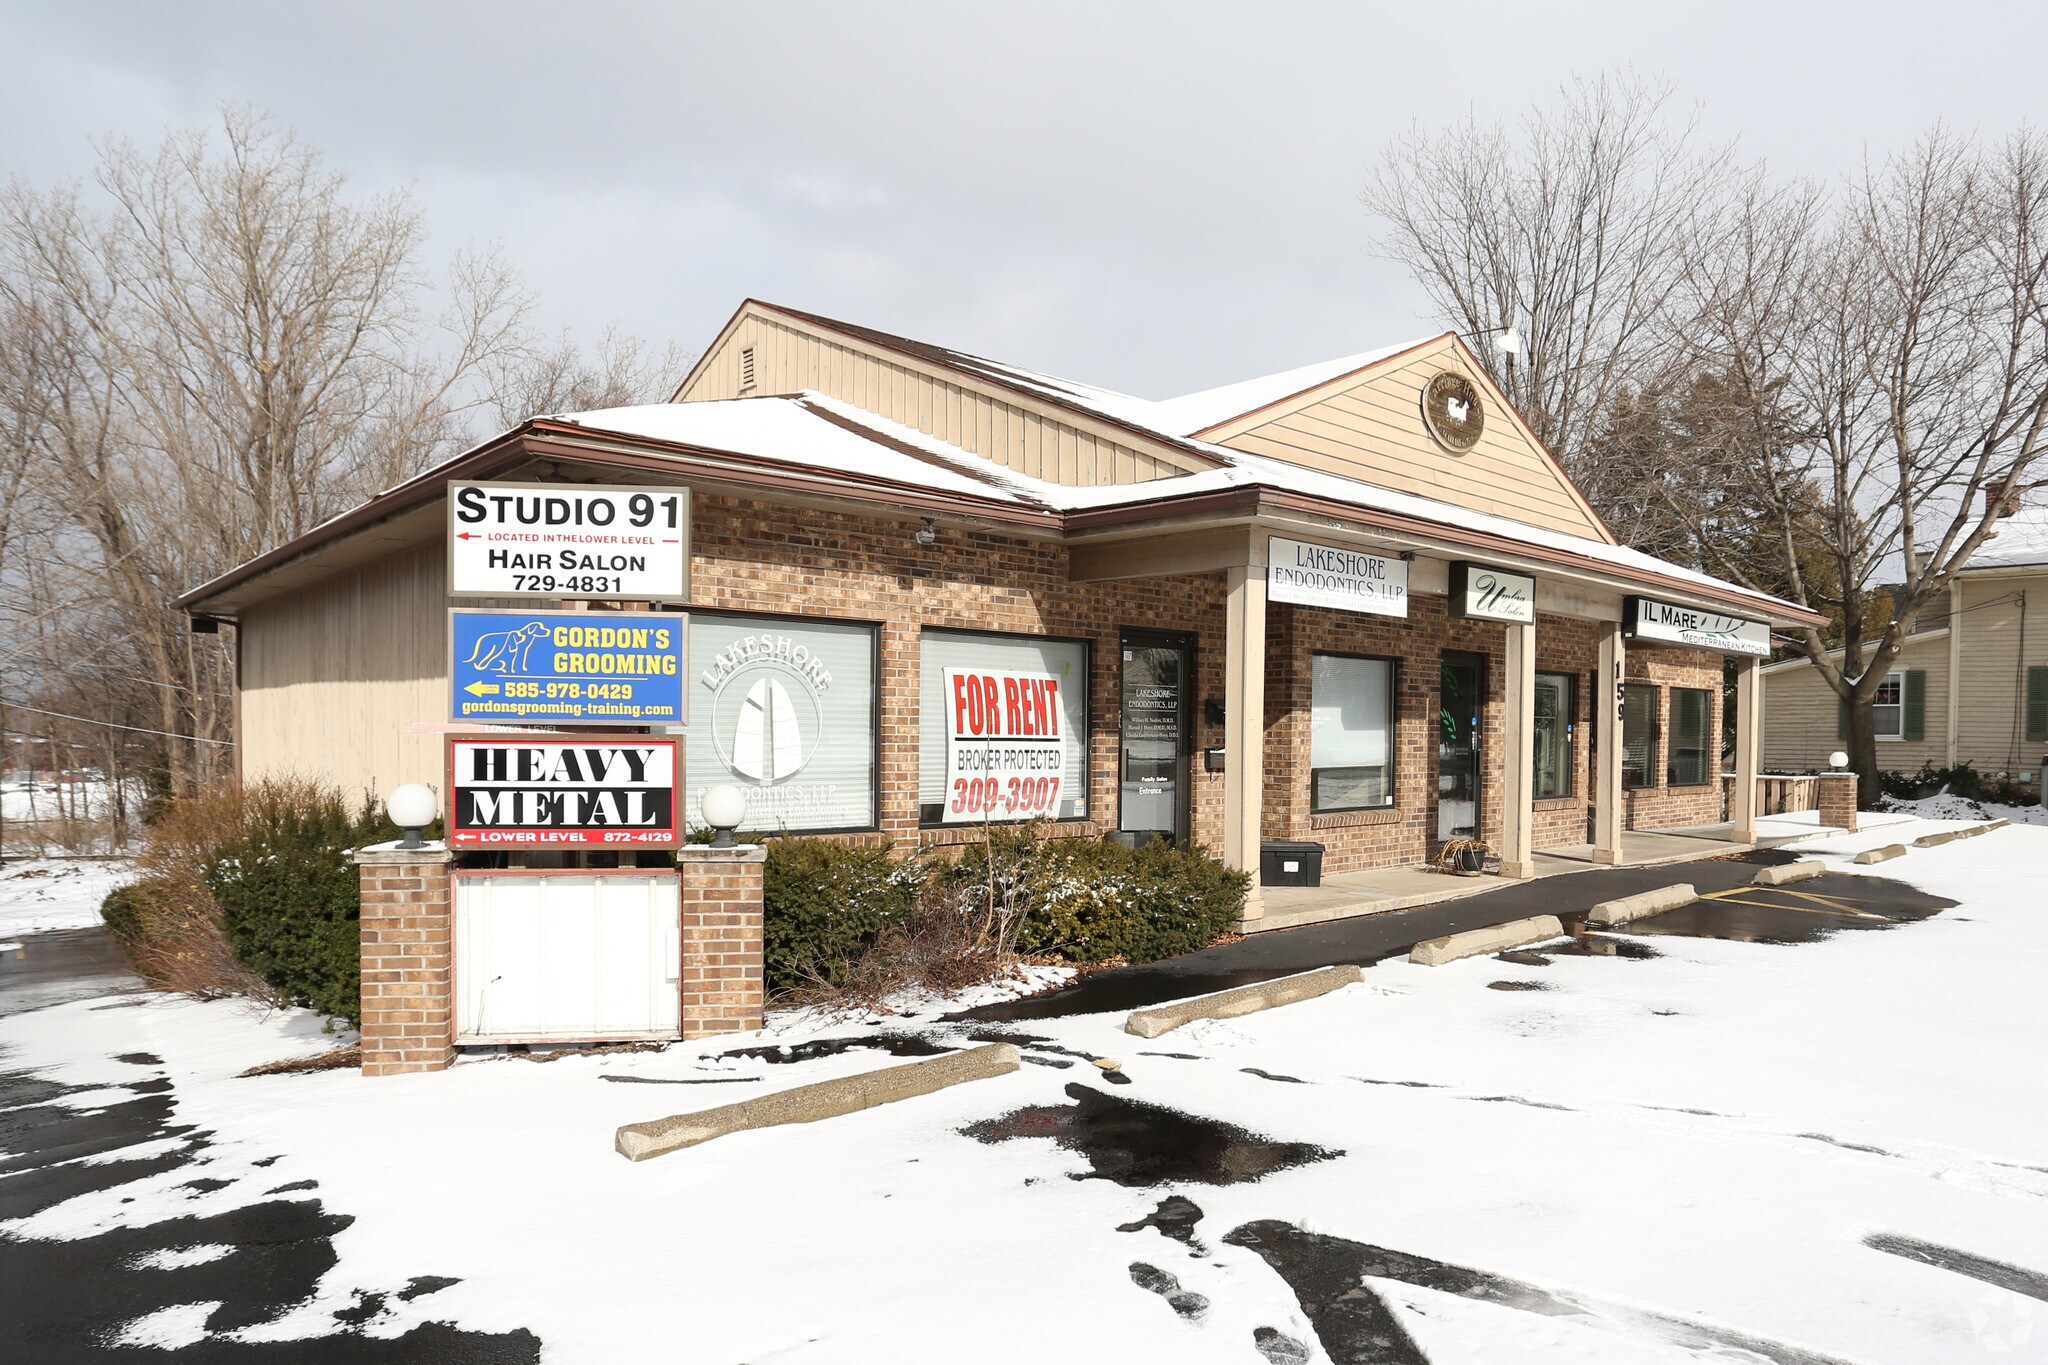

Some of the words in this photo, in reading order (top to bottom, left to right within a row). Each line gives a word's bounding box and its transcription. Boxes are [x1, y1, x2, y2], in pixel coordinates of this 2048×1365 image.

[457, 487, 616, 526] STUDIO
[628, 493, 678, 529] 91
[488, 532, 540, 542] LOCATED
[621, 536, 656, 545] LEVEL
[488, 549, 552, 570] HAIR
[559, 549, 646, 572] SALON
[1296, 544, 1387, 580] LAKESHORE
[512, 575, 622, 593] 729-4831
[1275, 567, 1378, 600] ENDODONTICS,
[1381, 584, 1404, 602] LLP
[1498, 601, 1526, 617] Salon
[1644, 601, 1658, 622] IL
[1661, 605, 1698, 630] MARE
[553, 626, 671, 649] GORDON'S
[1682, 632, 1740, 650] MEDITERRANEAN
[1741, 642, 1768, 655] KITCHEN
[553, 653, 677, 676] GROOMING
[701, 633, 834, 691] LAKESHORE
[504, 681, 633, 700] 585-978-0429
[1135, 689, 1171, 699] LAKESHORE
[462, 700, 674, 718] gordonsgrooming-training.com
[953, 674, 1001, 736] FOR
[1004, 677, 1059, 736] RENT
[1167, 701, 1178, 710] LLP
[484, 724, 522, 733] LOWER
[527, 724, 558, 733] LEVEL
[470, 748, 656, 782] HEAVY
[958, 749, 1001, 771] BROKER
[1004, 749, 1061, 771] PROTECTED
[951, 776, 1060, 814] 309-3907
[1139, 786, 1163, 795] Entrance
[469, 790, 656, 826] METAL
[480, 832, 543, 842] LOWER
[546, 832, 588, 842] LEVEL
[603, 832, 673, 842] 872-4129
